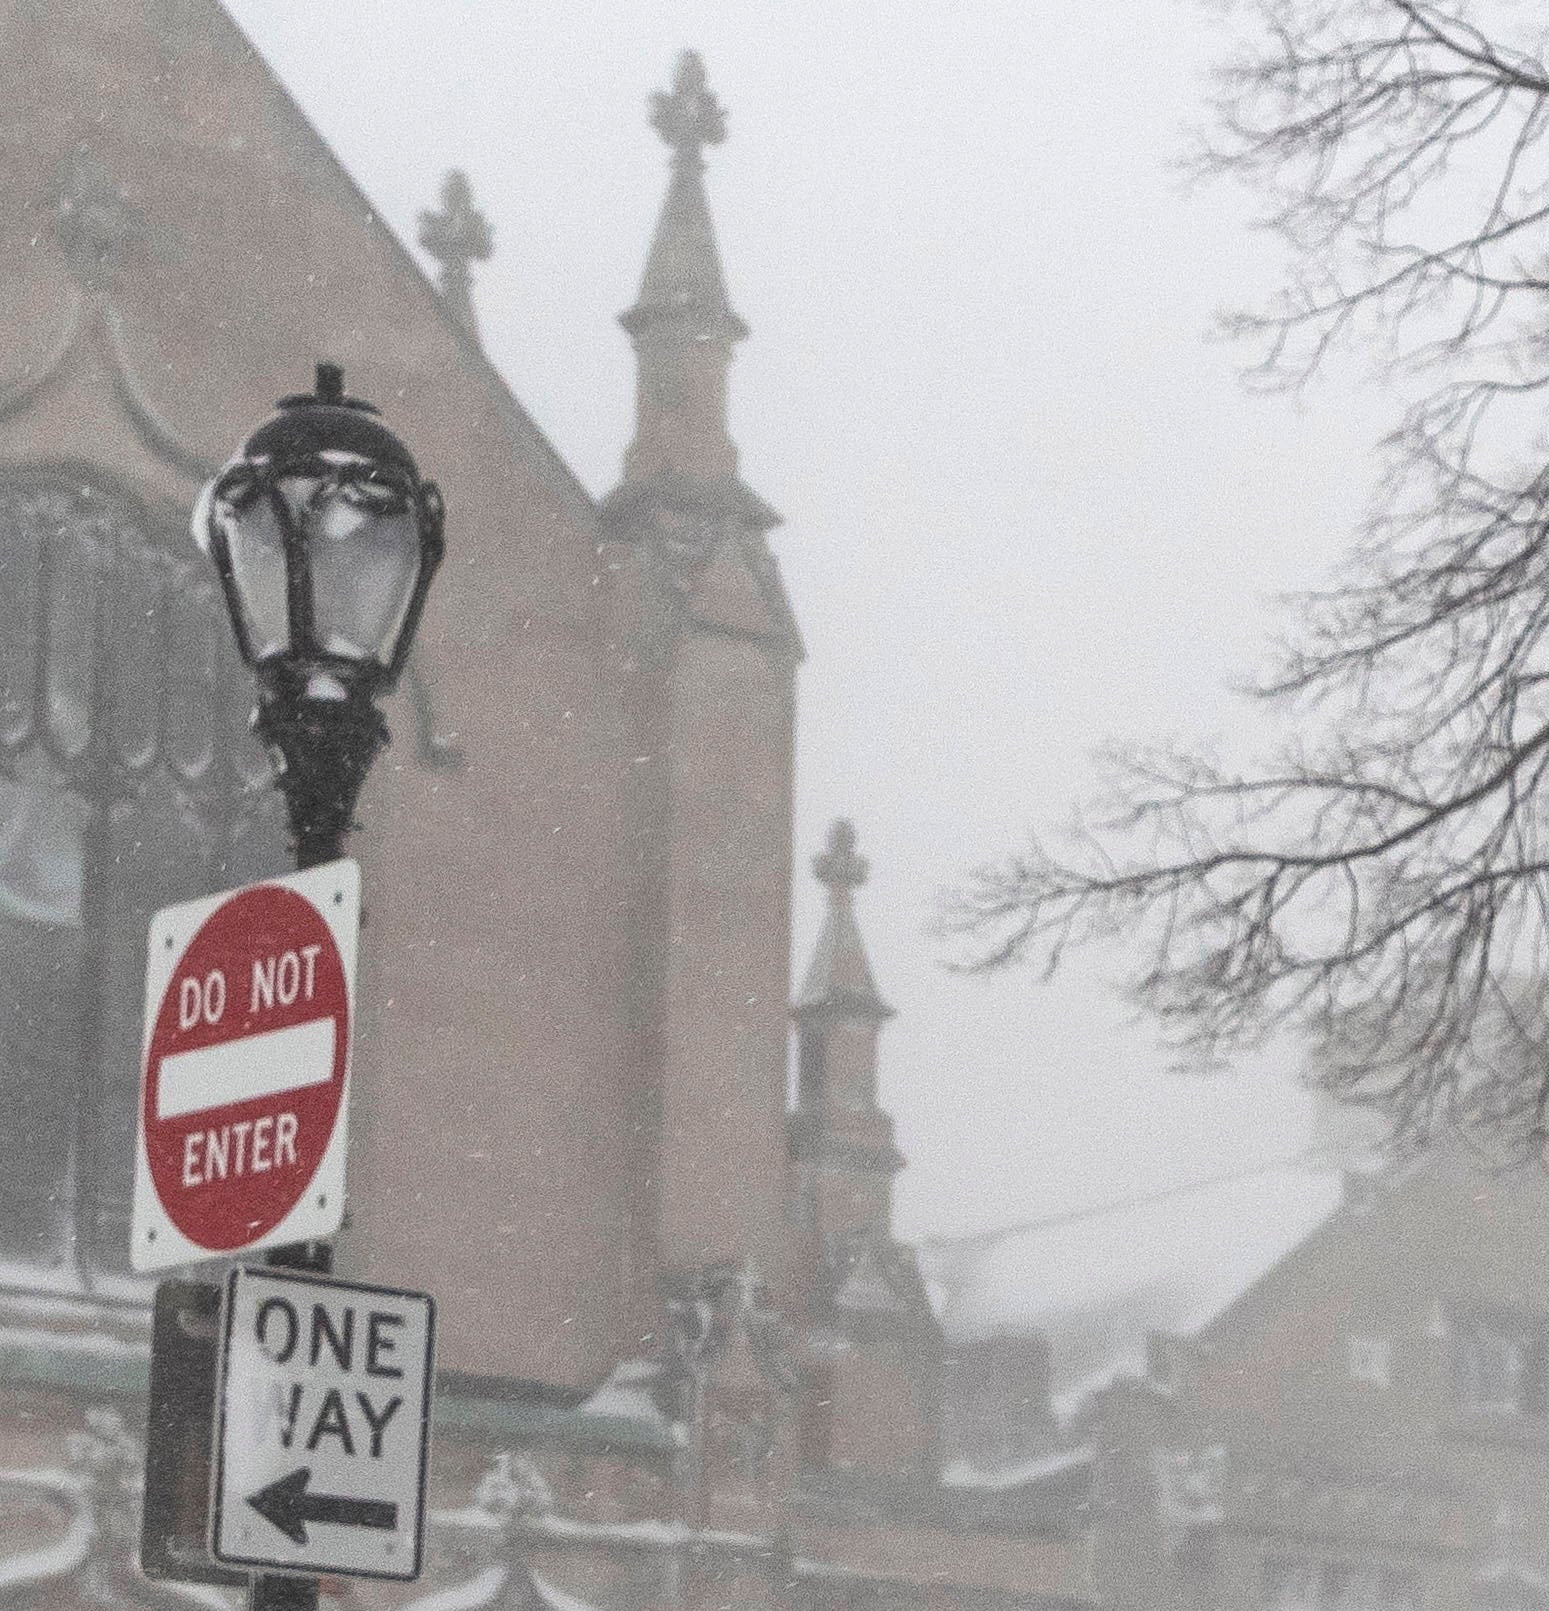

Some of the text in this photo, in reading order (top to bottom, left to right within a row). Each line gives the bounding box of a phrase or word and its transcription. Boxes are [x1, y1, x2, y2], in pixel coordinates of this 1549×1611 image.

[179, 944, 321, 1031] DO NOT
[182, 1112, 299, 1187] ENTER
[255, 1296, 404, 1379] ONE
